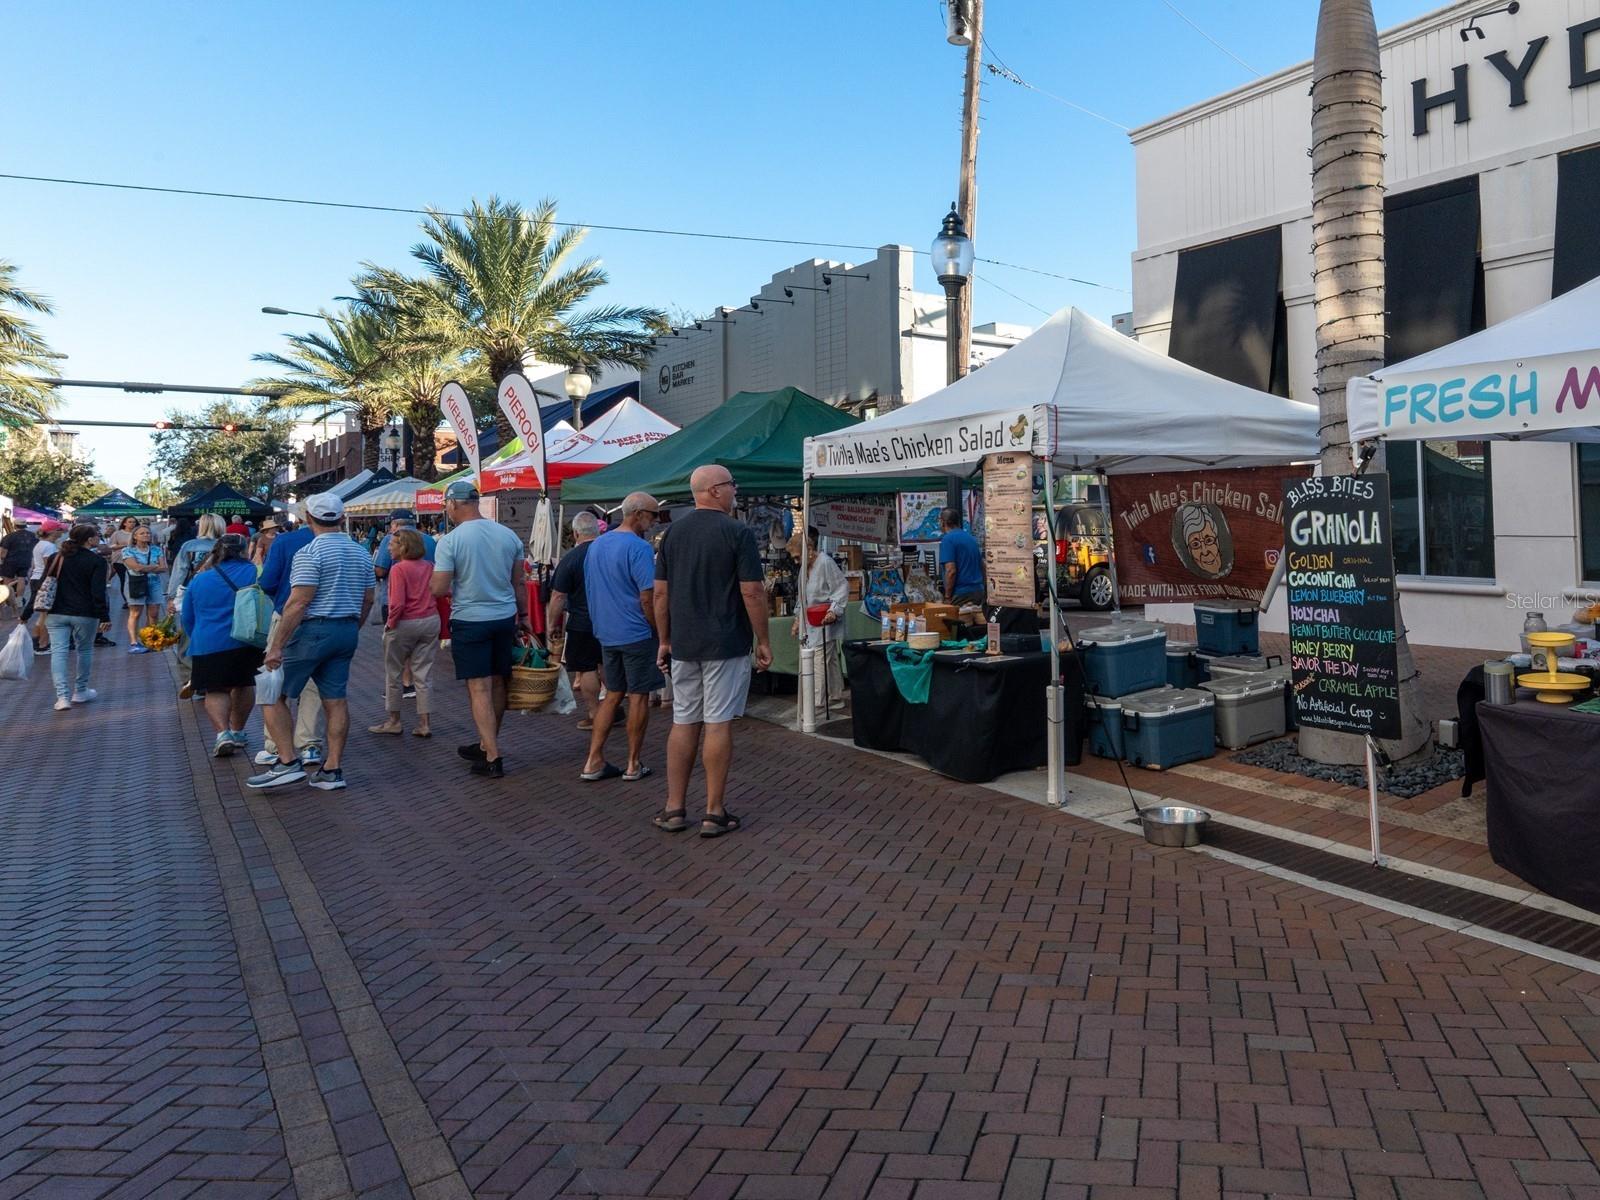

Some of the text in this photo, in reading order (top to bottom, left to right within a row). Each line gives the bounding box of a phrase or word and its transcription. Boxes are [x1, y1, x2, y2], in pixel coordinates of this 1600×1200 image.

[672, 360, 695, 372] KITCHEN
[672, 372, 684, 380] BAR
[672, 376, 694, 388] MARKET
[1385, 371, 1538, 427] FRESH
[504, 386, 540, 454] PIEROGI
[828, 420, 1004, 467] Twila Mae's Chicken Salad
[996, 455, 1015, 464] Menu
[1286, 475, 1374, 508] BLISS BITES
[1120, 481, 1285, 531] Twila Mae's Chicken Sal
[1289, 571, 1335, 587] COCONUT
[1335, 574, 1356, 589] CHIA
[1119, 585, 1146, 598] MADE
[1149, 584, 1174, 598] WITH
[1176, 583, 1199, 597] LOVE
[1200, 584, 1224, 597] FROM
[1225, 585, 1242, 597] OUR
[1290, 590, 1318, 602] LEMON
[1320, 589, 1365, 606] BLUEBERRY
[1290, 605, 1340, 623] HOLY CHAI
[1321, 625, 1351, 640] BUTTER
[1353, 627, 1398, 643] CHOCOLATE
[1292, 640, 1354, 661] HONEY BERRY
[1292, 656, 1359, 678] SAVOR THE DAY
[1318, 678, 1398, 700] CARAMEL APPLE
[1296, 694, 1308, 710] No
[1349, 703, 1373, 723] Crap
